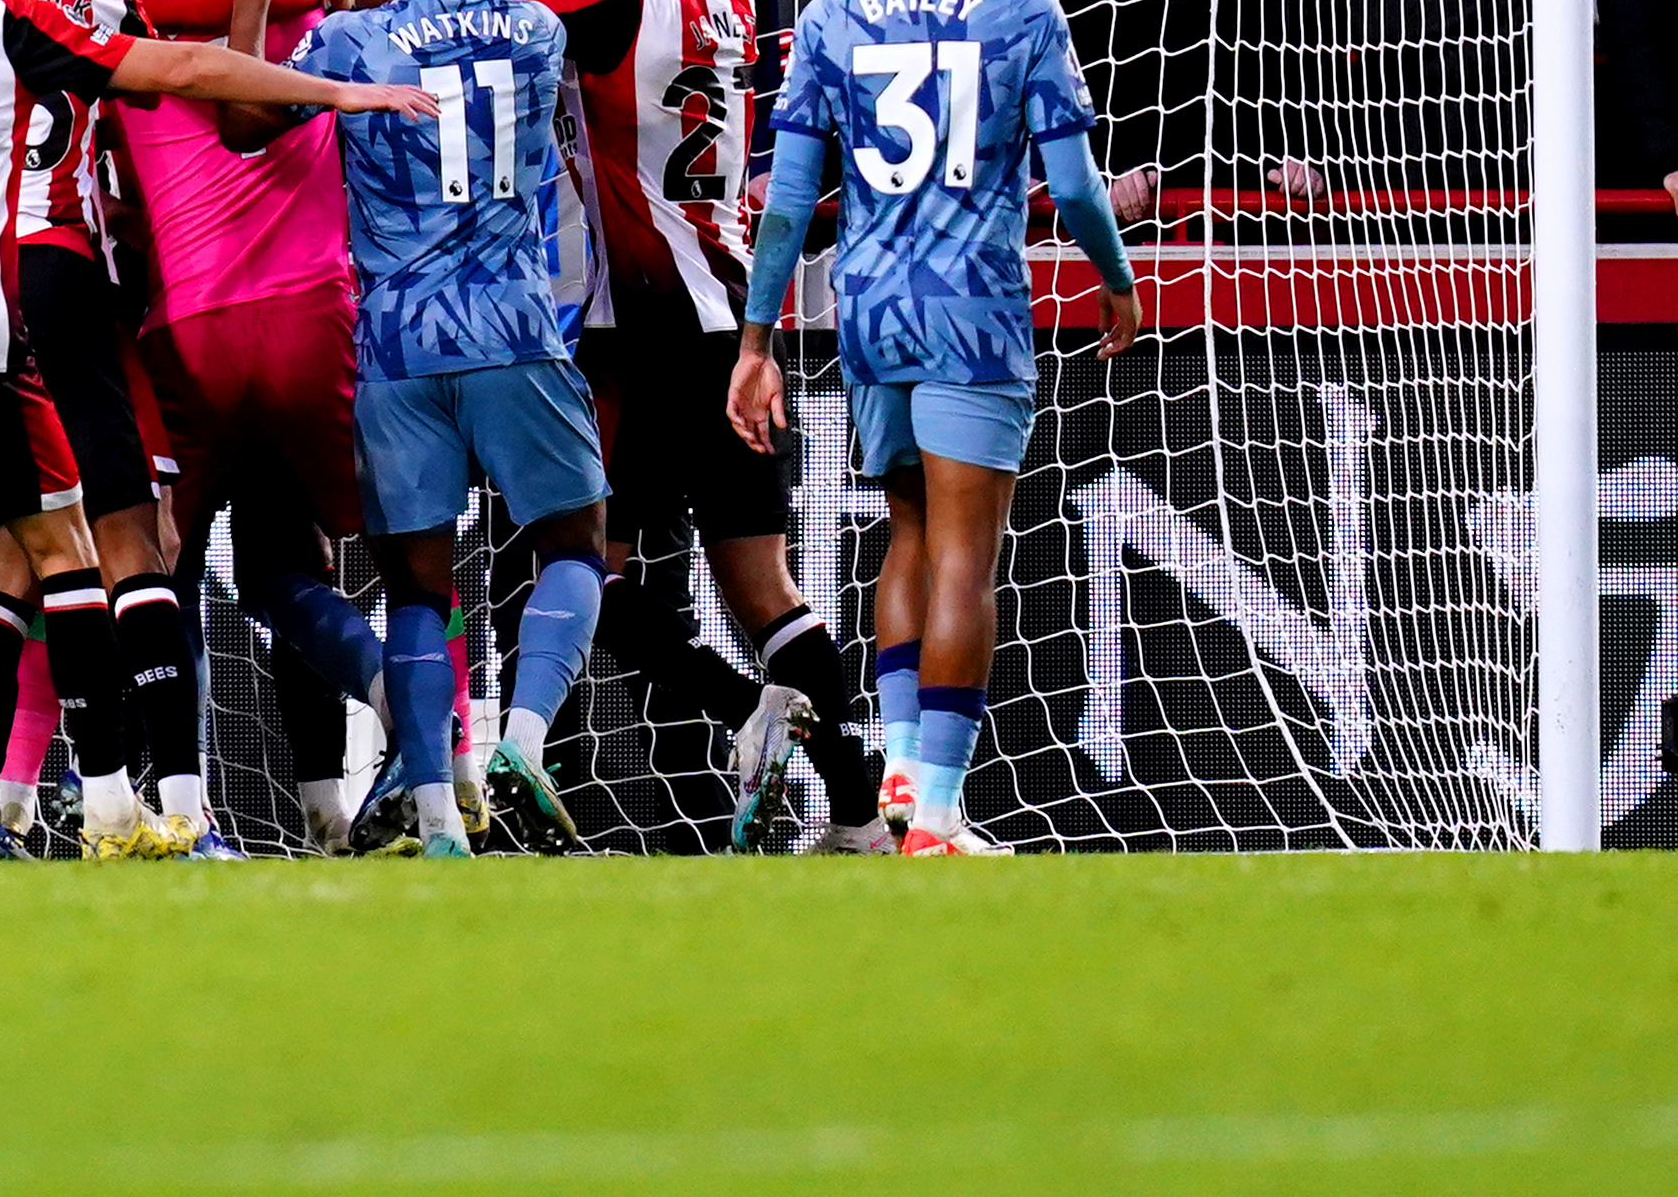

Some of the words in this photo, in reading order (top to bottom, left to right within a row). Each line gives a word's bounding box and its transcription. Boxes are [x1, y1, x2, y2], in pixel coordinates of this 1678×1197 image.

[389, 10, 534, 55] WATKINS
[420, 59, 517, 203] 11
[852, 40, 982, 195] 31
[134, 665, 178, 687] BEES
